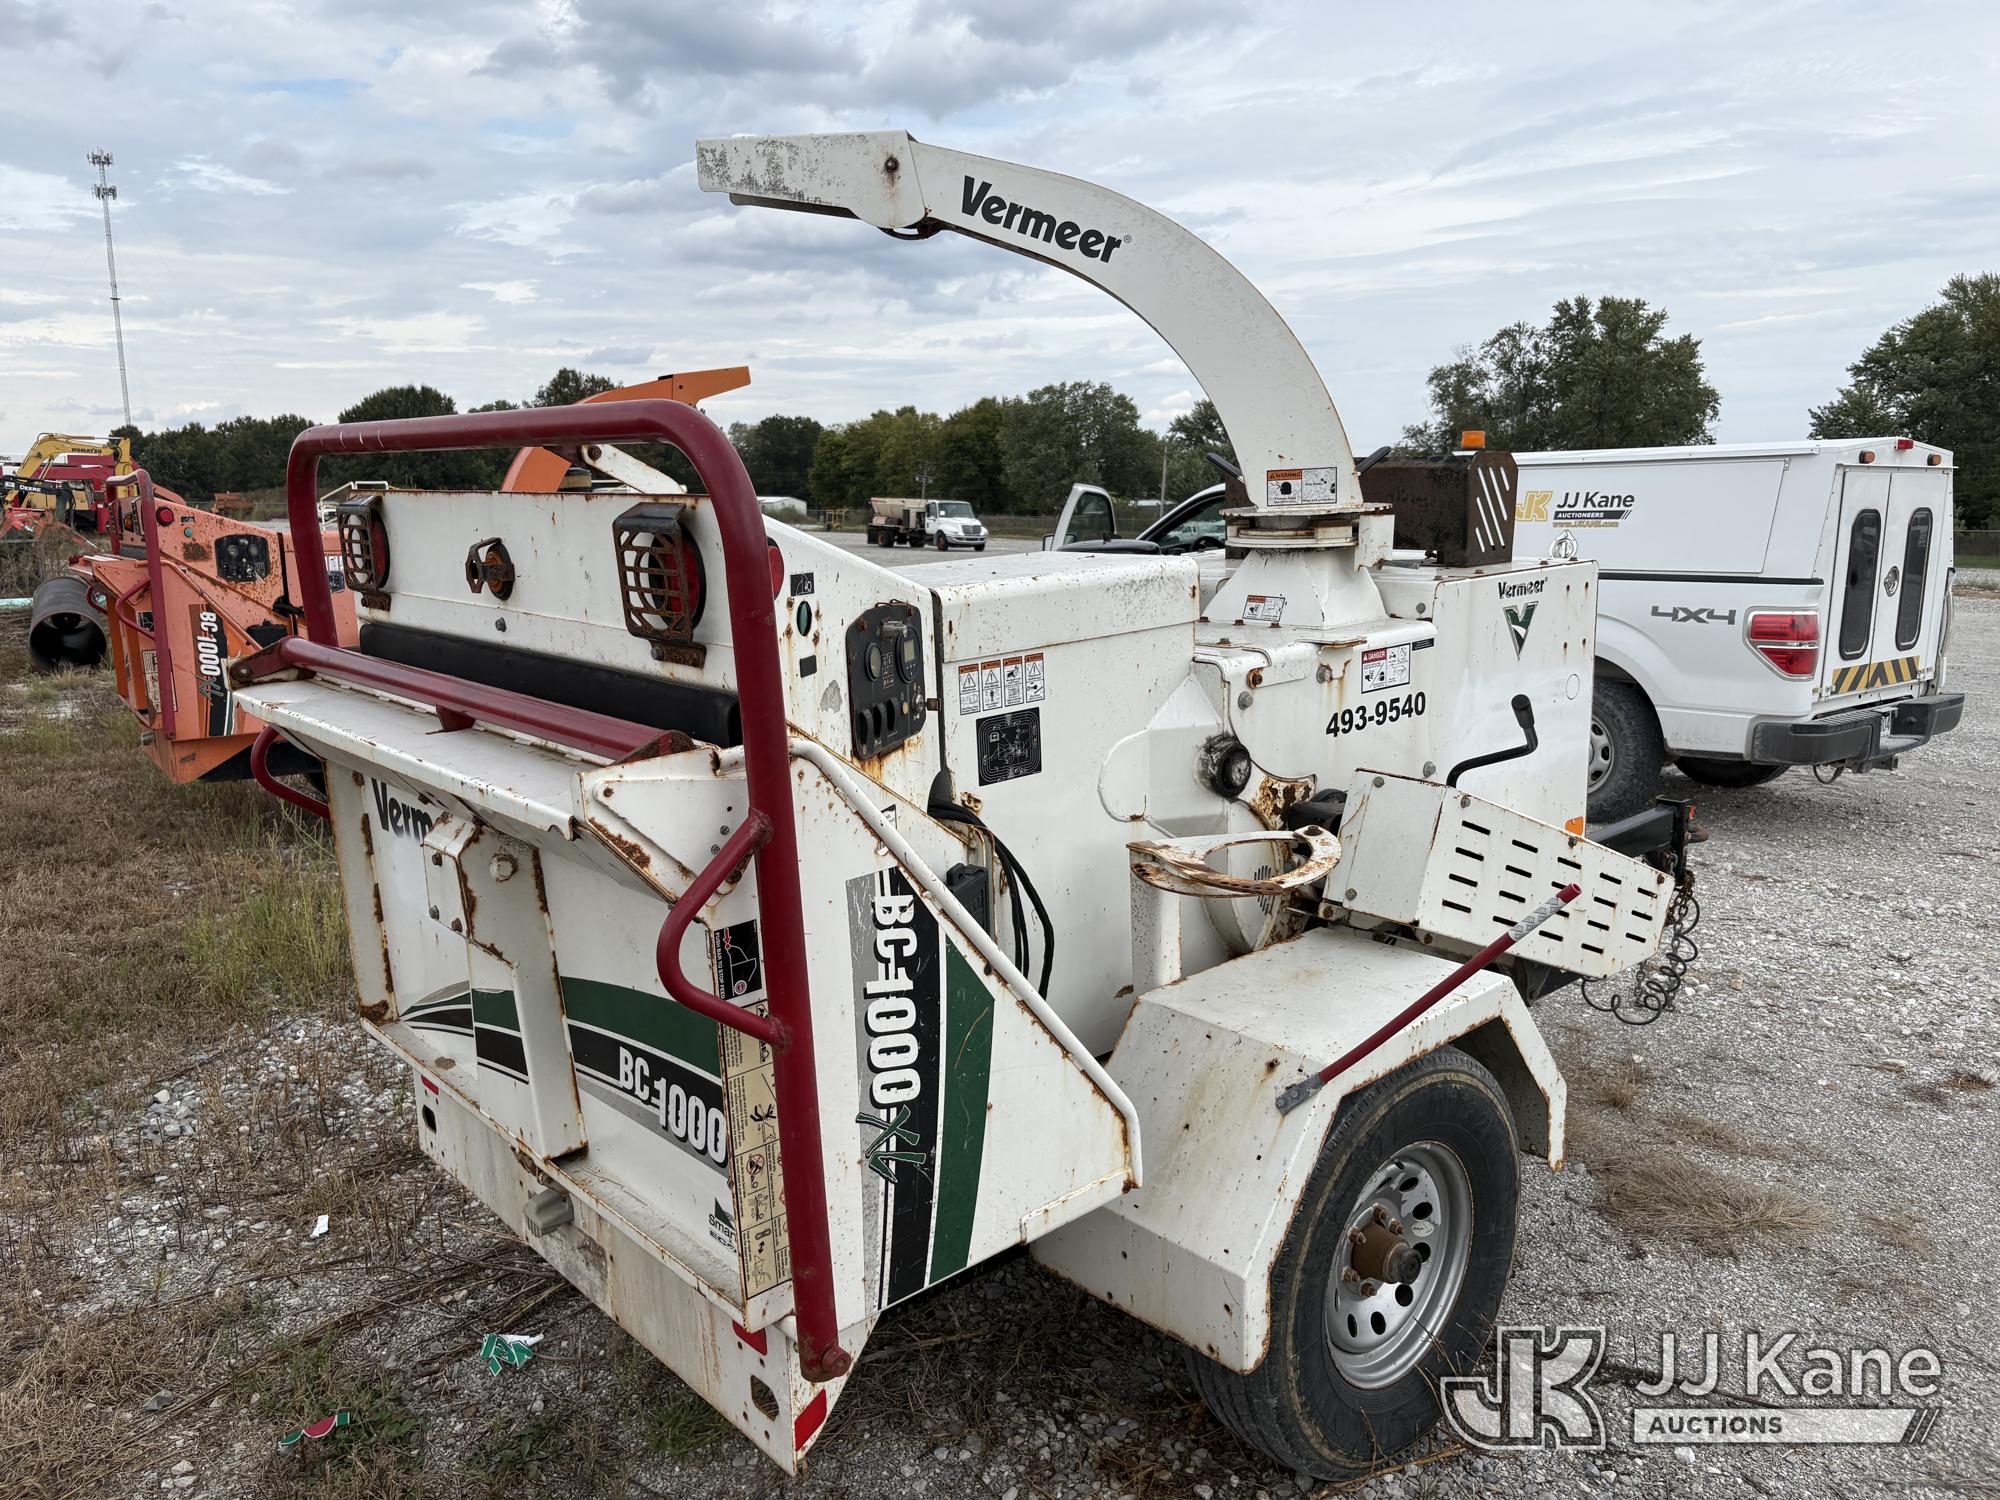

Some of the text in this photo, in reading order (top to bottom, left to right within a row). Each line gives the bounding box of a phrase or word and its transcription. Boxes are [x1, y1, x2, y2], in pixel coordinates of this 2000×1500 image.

[19, 484, 41, 492] DEERE
[1556, 491, 1635, 508] JJ Kane
[1367, 650, 1386, 660] DANGER
[1325, 691, 1426, 738] 493-9540
[619, 1046, 727, 1164] BC-1000
